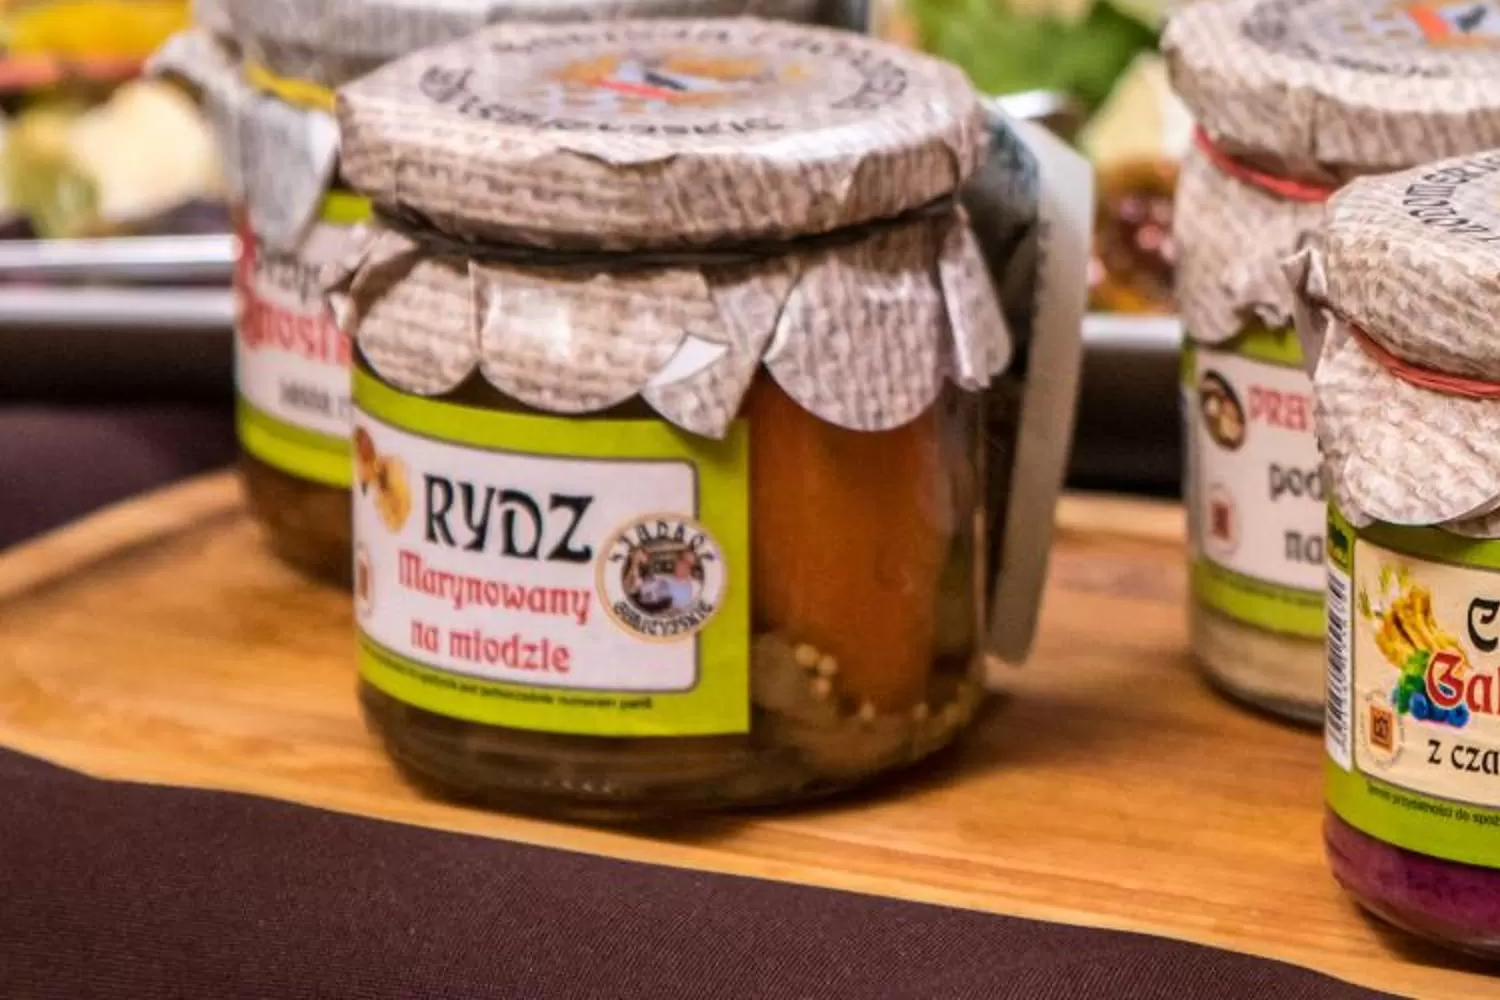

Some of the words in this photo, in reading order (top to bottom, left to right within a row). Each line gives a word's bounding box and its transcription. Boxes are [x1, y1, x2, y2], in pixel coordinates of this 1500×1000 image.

[423, 473, 595, 564] RYDZ
[397, 549, 592, 626] Marynowany
[410, 618, 440, 654] na
[449, 628, 572, 674] miodzie
[1427, 739, 1443, 766] z
